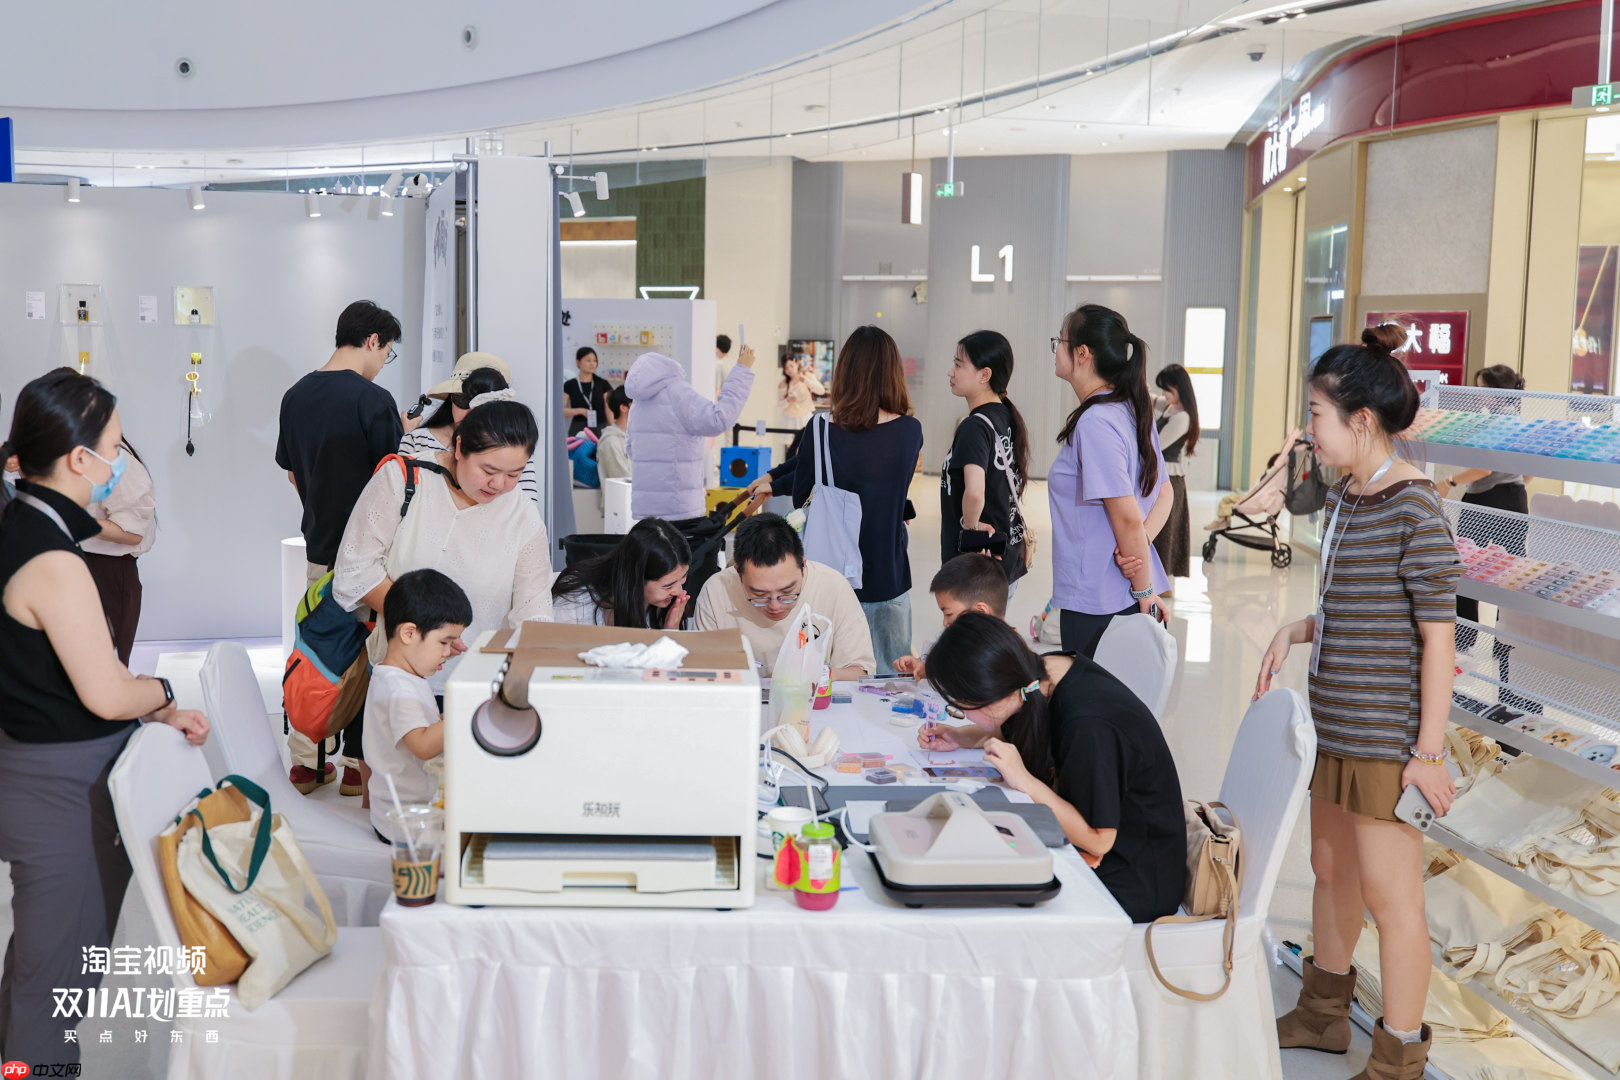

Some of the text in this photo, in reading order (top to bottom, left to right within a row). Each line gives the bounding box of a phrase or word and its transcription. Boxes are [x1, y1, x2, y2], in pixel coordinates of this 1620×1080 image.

[971, 244, 1014, 282] L1
[1378, 321, 1452, 354] 大福
[1452, 691, 1489, 716] 宝视频
